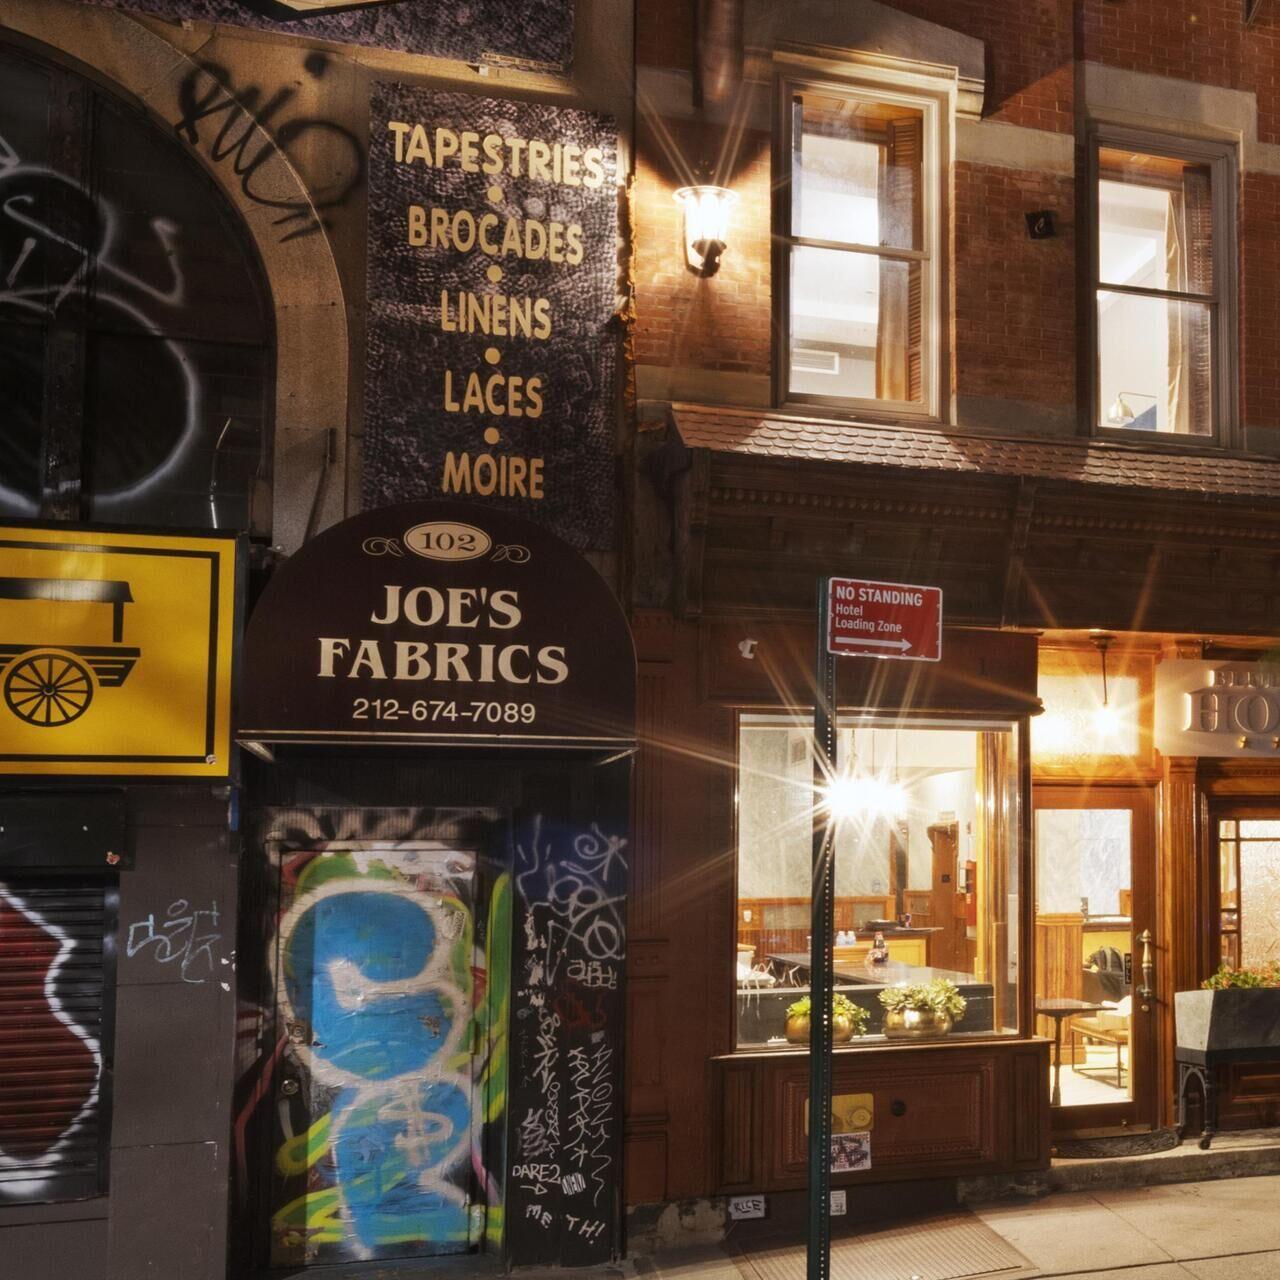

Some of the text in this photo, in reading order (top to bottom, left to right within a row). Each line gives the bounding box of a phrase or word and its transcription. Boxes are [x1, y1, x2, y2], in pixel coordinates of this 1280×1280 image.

[387, 120, 605, 189] TAPESTRIES
[408, 204, 584, 266] BROCADES
[440, 289, 551, 340] LINENS
[444, 369, 544, 419] LACES
[441, 451, 545, 500] MOIRE
[420, 531, 477, 552] 102
[370, 584, 522, 630] JOE'S
[835, 585, 923, 607] NO STANDING
[835, 603, 863, 616] Hotel
[835, 617, 902, 633] Loading Zone
[317, 637, 569, 685] FABRICS
[352, 697, 536, 724] 212-674-7089
[734, 1199, 763, 1214] RICE
